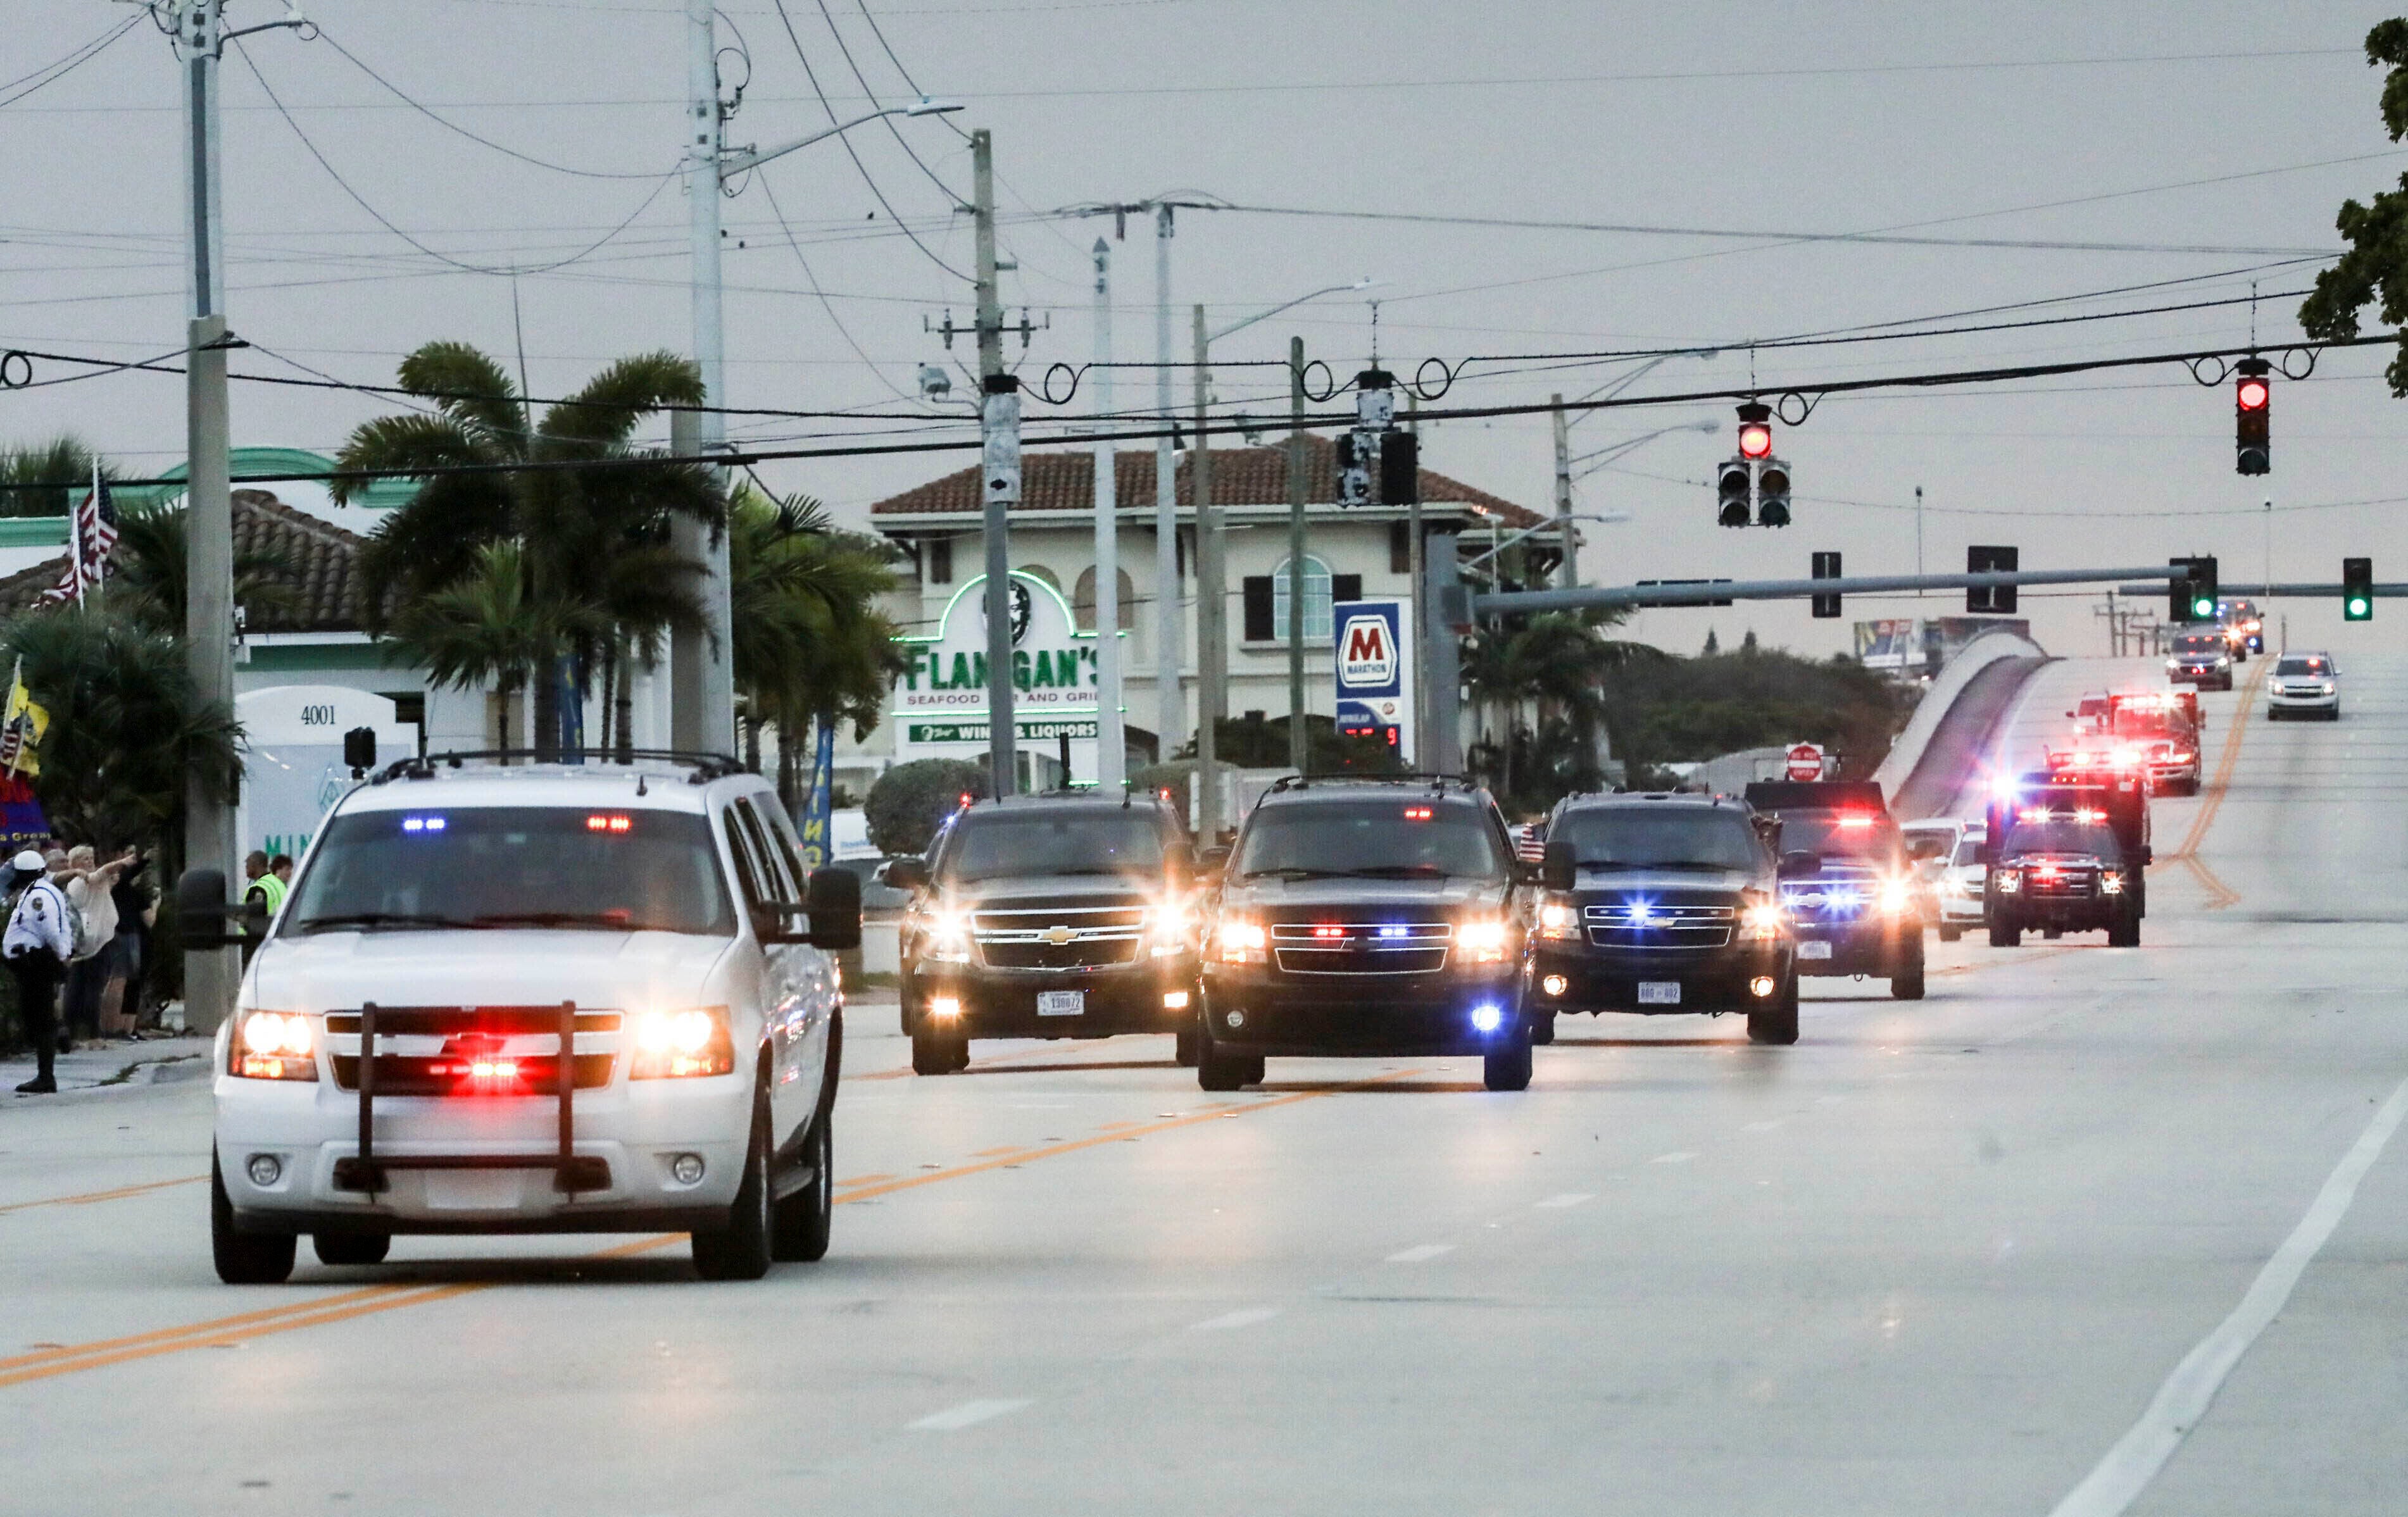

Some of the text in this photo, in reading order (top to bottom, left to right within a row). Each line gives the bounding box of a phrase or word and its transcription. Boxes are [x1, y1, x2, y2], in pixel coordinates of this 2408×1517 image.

[1348, 628, 1384, 661] M
[905, 645, 1098, 692] FLANGAN'S
[907, 695, 980, 705] SEAFOOD
[1027, 694, 1058, 702] AND
[301, 706, 335, 725] 4001
[958, 725, 991, 739] WIN
[1030, 724, 1096, 738] LIQUORS
